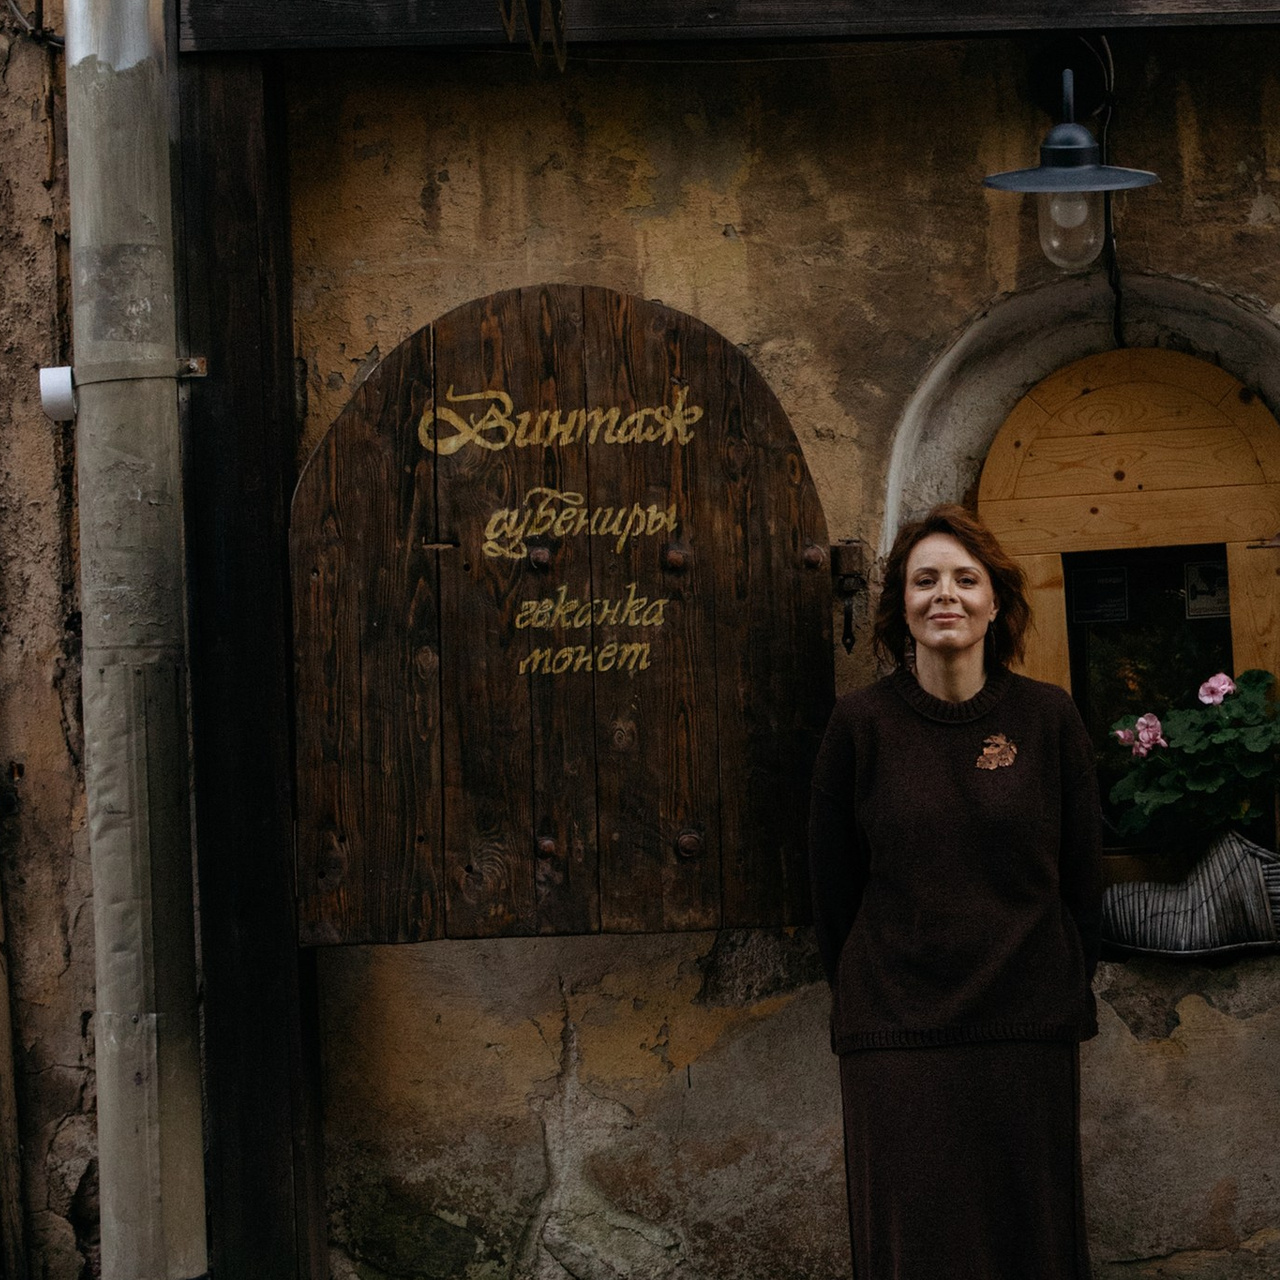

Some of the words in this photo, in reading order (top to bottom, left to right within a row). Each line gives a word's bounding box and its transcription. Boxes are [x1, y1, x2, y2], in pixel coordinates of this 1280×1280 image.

[417, 384, 704, 455] Винтаж
[481, 486, 678, 559] сувениры
[518, 641, 652, 676] монет
